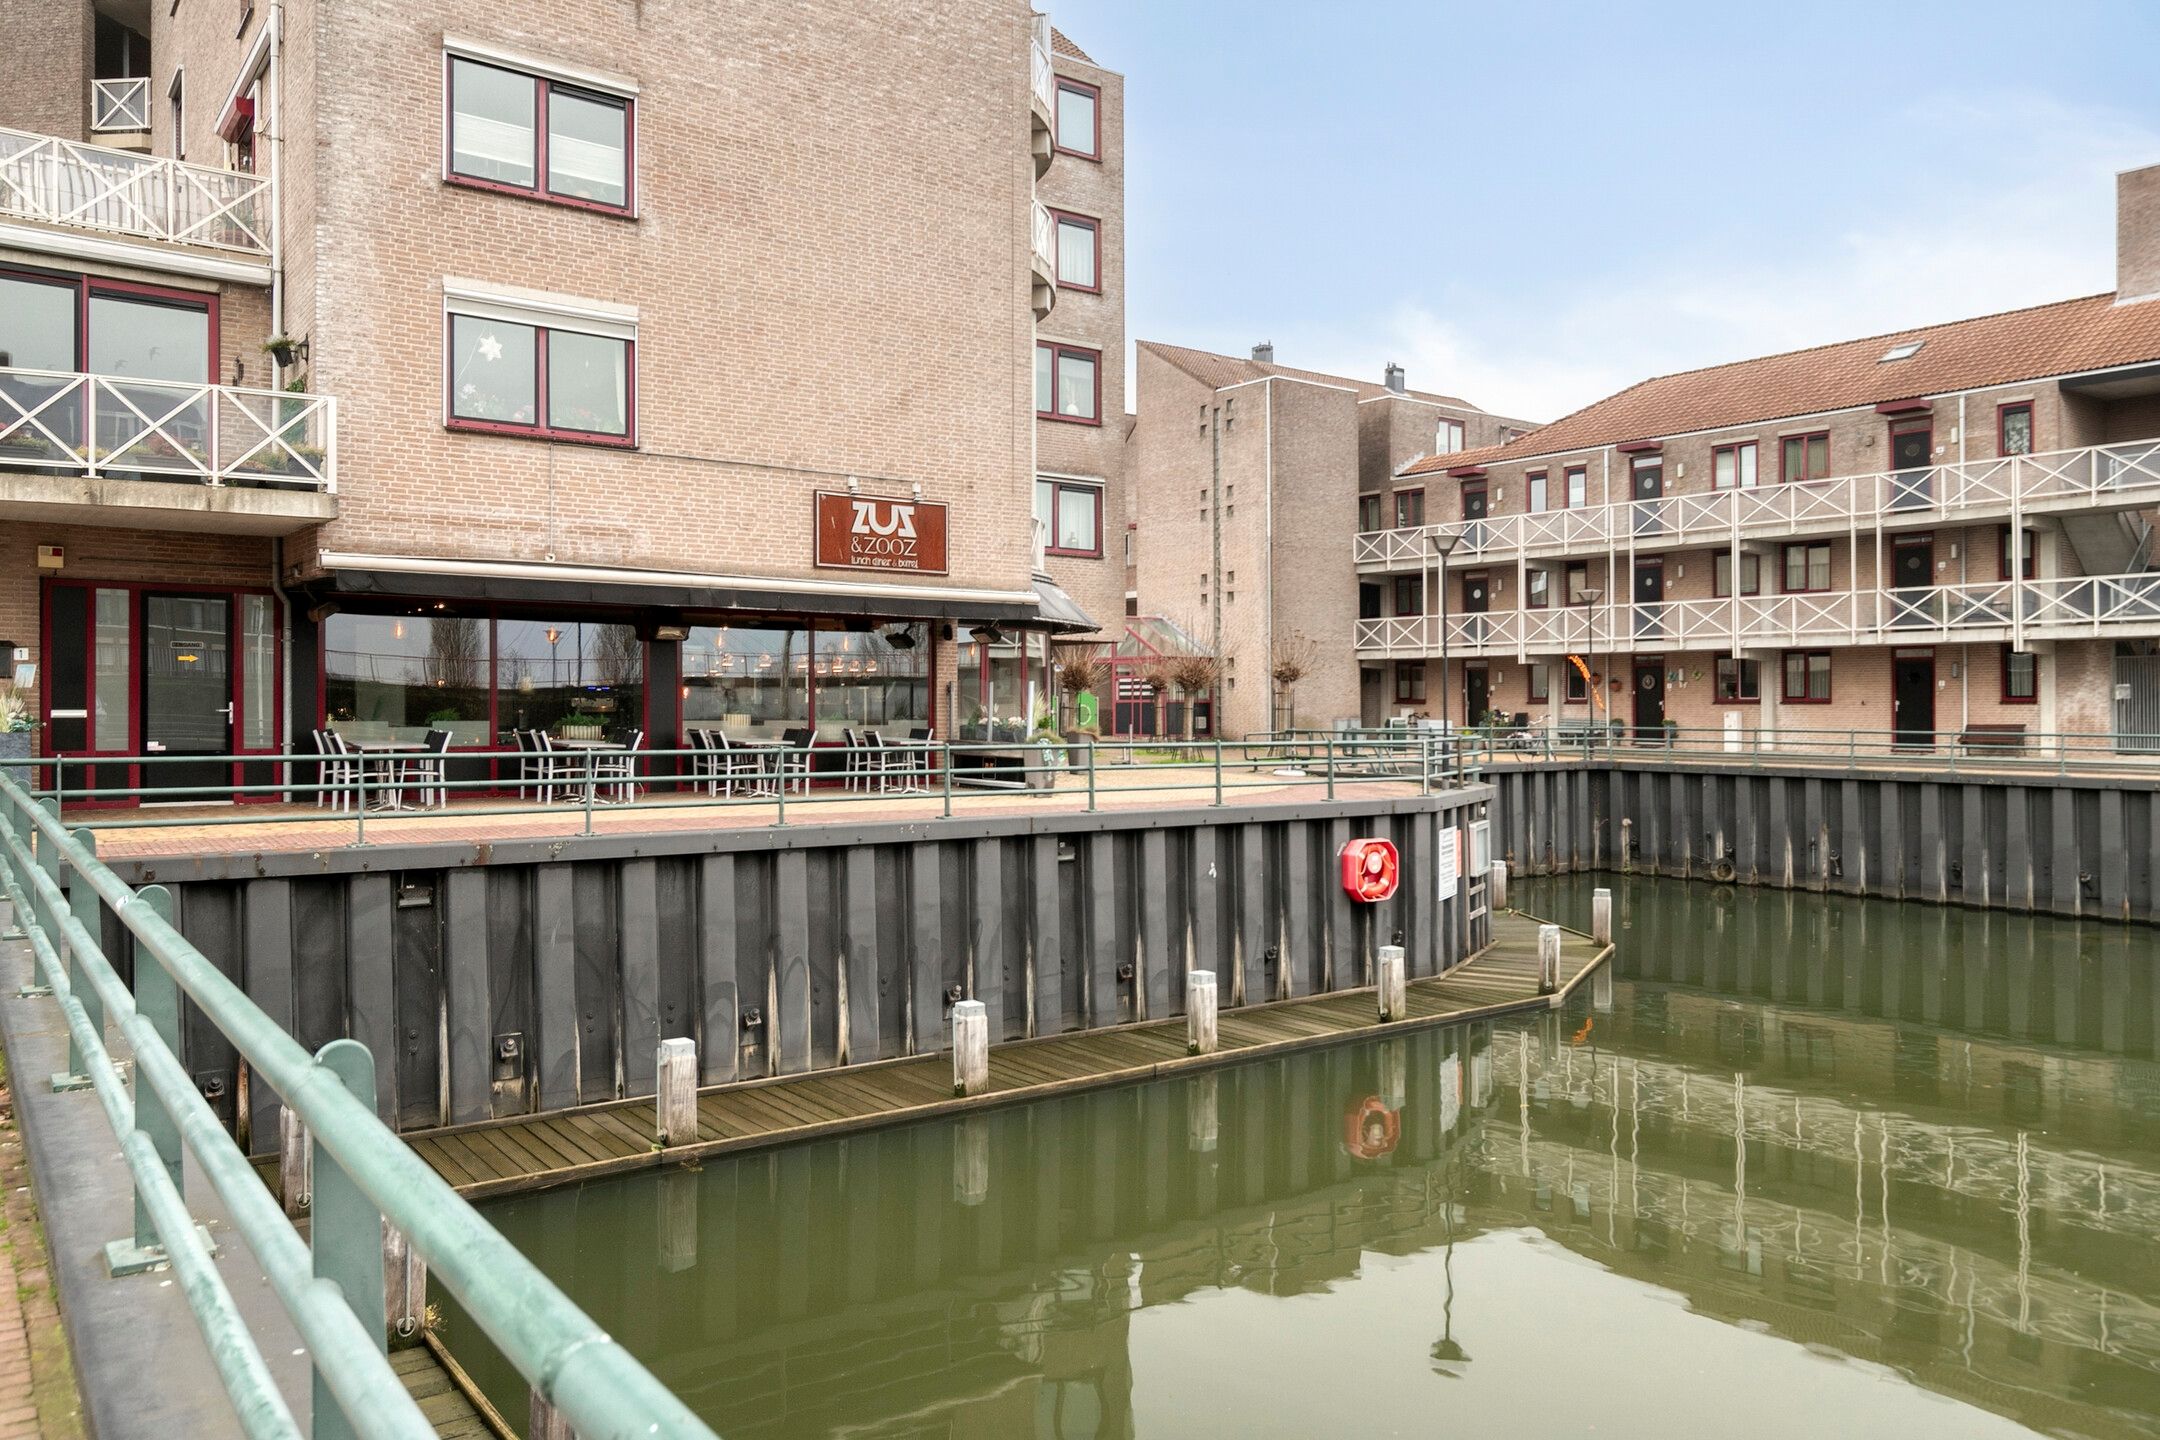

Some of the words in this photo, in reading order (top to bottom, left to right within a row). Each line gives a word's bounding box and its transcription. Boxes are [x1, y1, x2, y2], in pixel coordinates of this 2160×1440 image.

[864, 537, 917, 556] ZOOZ
[851, 555, 871, 566] lunch
[872, 556, 892, 567] diner
